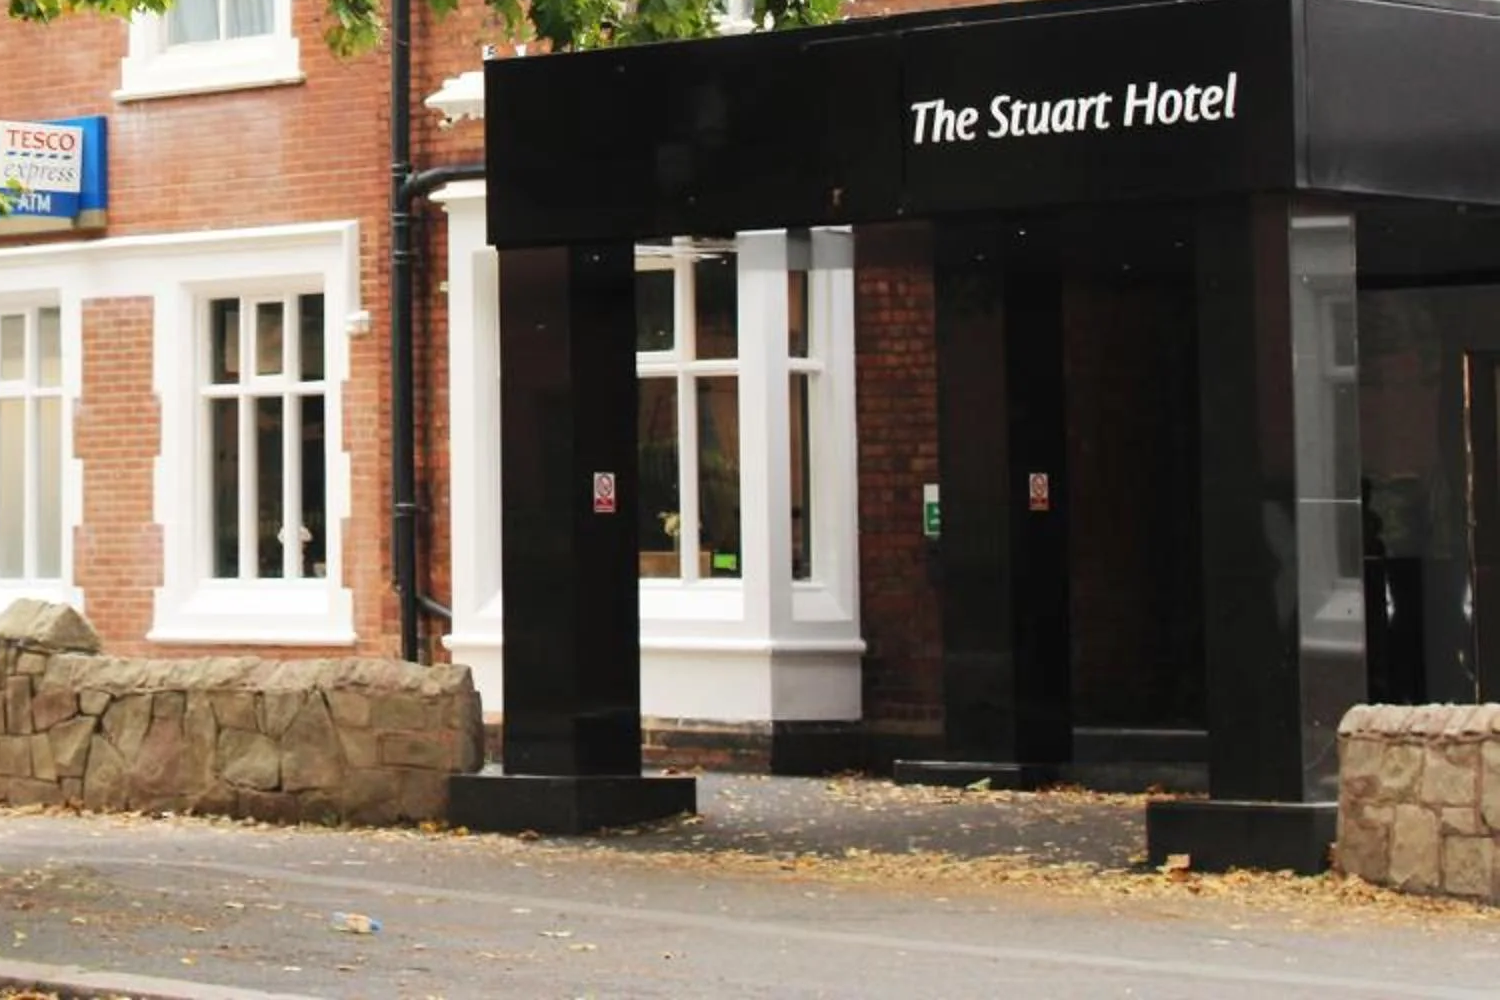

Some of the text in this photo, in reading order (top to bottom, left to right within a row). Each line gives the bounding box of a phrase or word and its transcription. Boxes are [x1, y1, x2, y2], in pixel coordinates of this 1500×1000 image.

[911, 72, 1237, 144] The Stuart Hotel
[6, 129, 75, 151] TESCO
[4, 162, 76, 184] express
[18, 193, 51, 213] ATM
